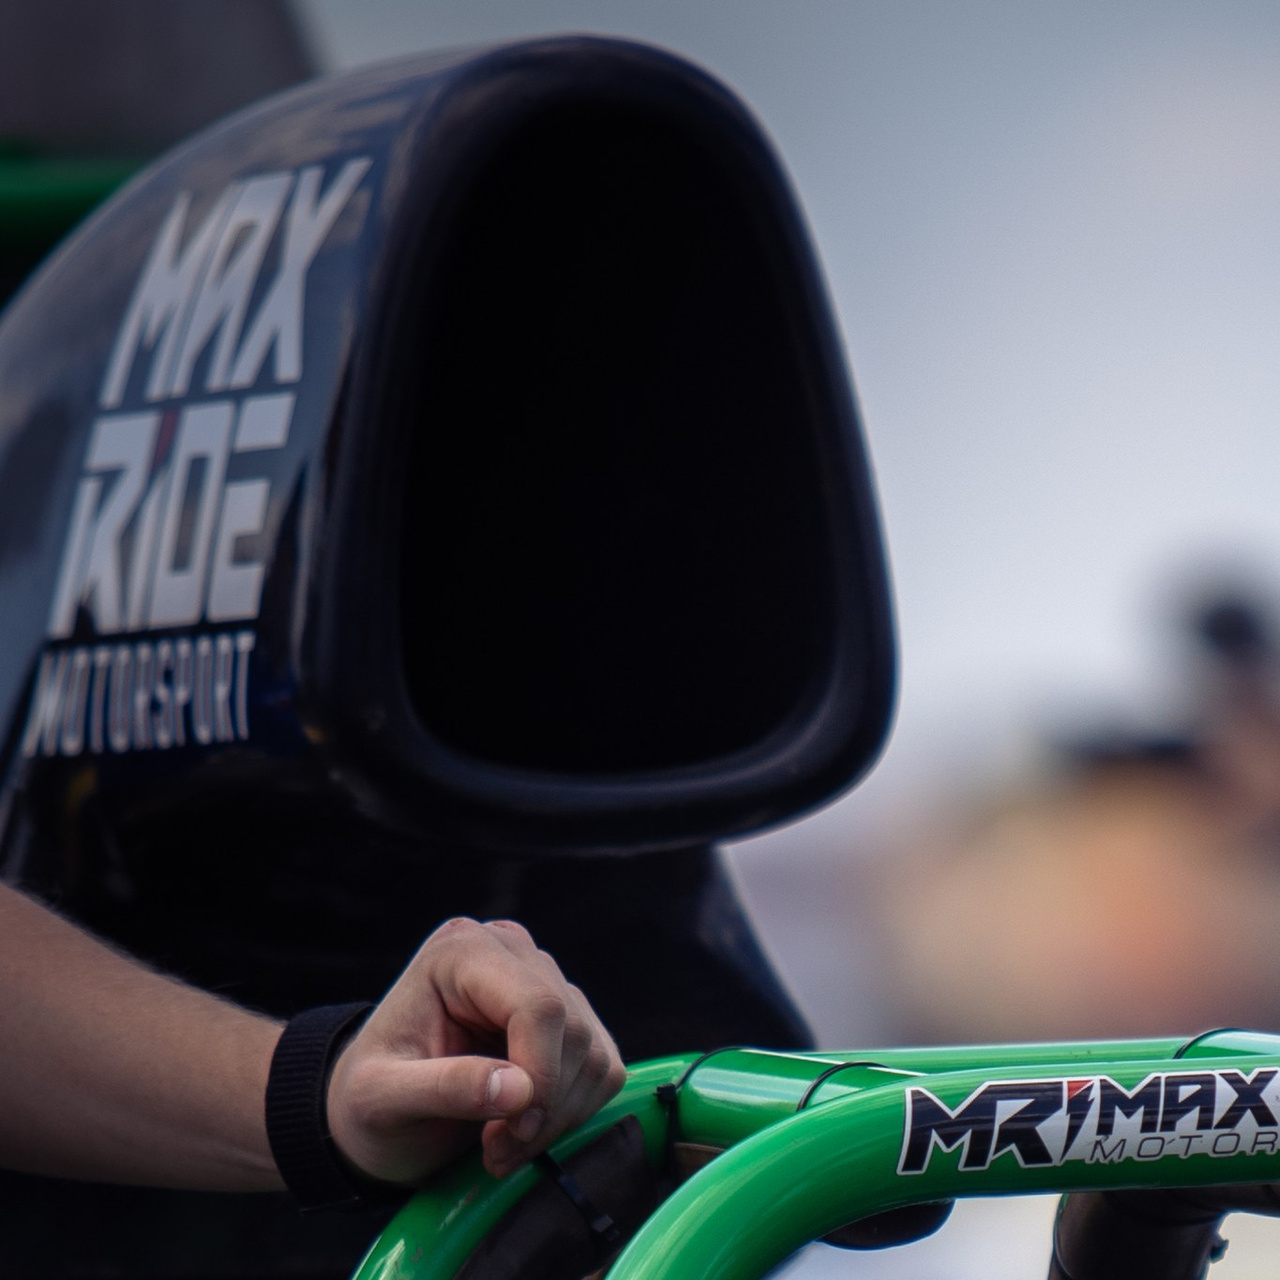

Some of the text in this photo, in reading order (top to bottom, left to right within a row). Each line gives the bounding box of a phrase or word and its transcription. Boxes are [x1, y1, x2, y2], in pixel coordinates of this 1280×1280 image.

[101, 156, 373, 407] MAX
[48, 392, 296, 638] RIDE
[22, 630, 257, 758] MOTORSPORT
